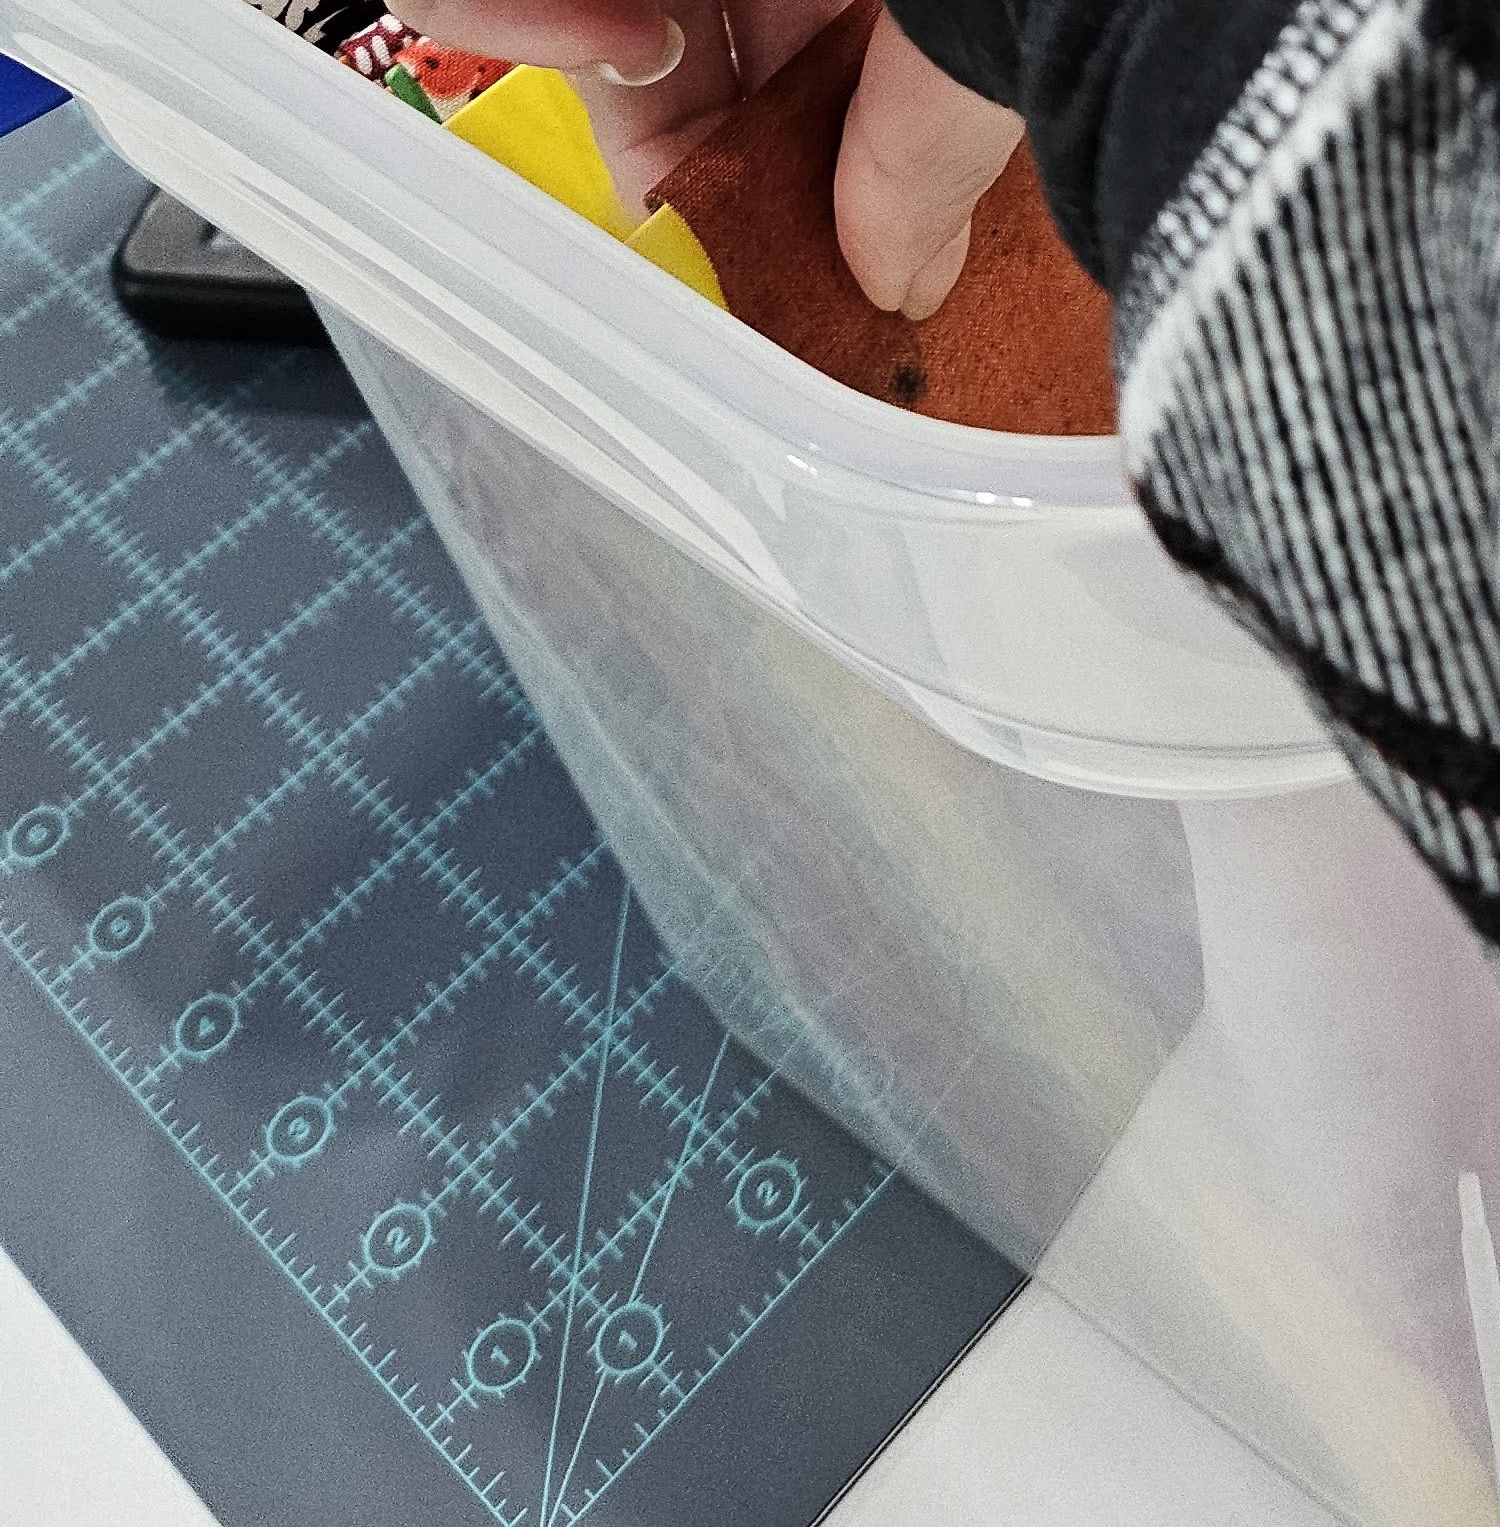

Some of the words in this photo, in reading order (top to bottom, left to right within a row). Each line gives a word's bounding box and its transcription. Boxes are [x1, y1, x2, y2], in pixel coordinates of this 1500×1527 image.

[288, 1117, 310, 1141] 3
[756, 1179, 781, 1207] 2
[385, 1225, 411, 1254] 2
[618, 1330, 637, 1350] 1
[490, 1346, 510, 1366] 1
